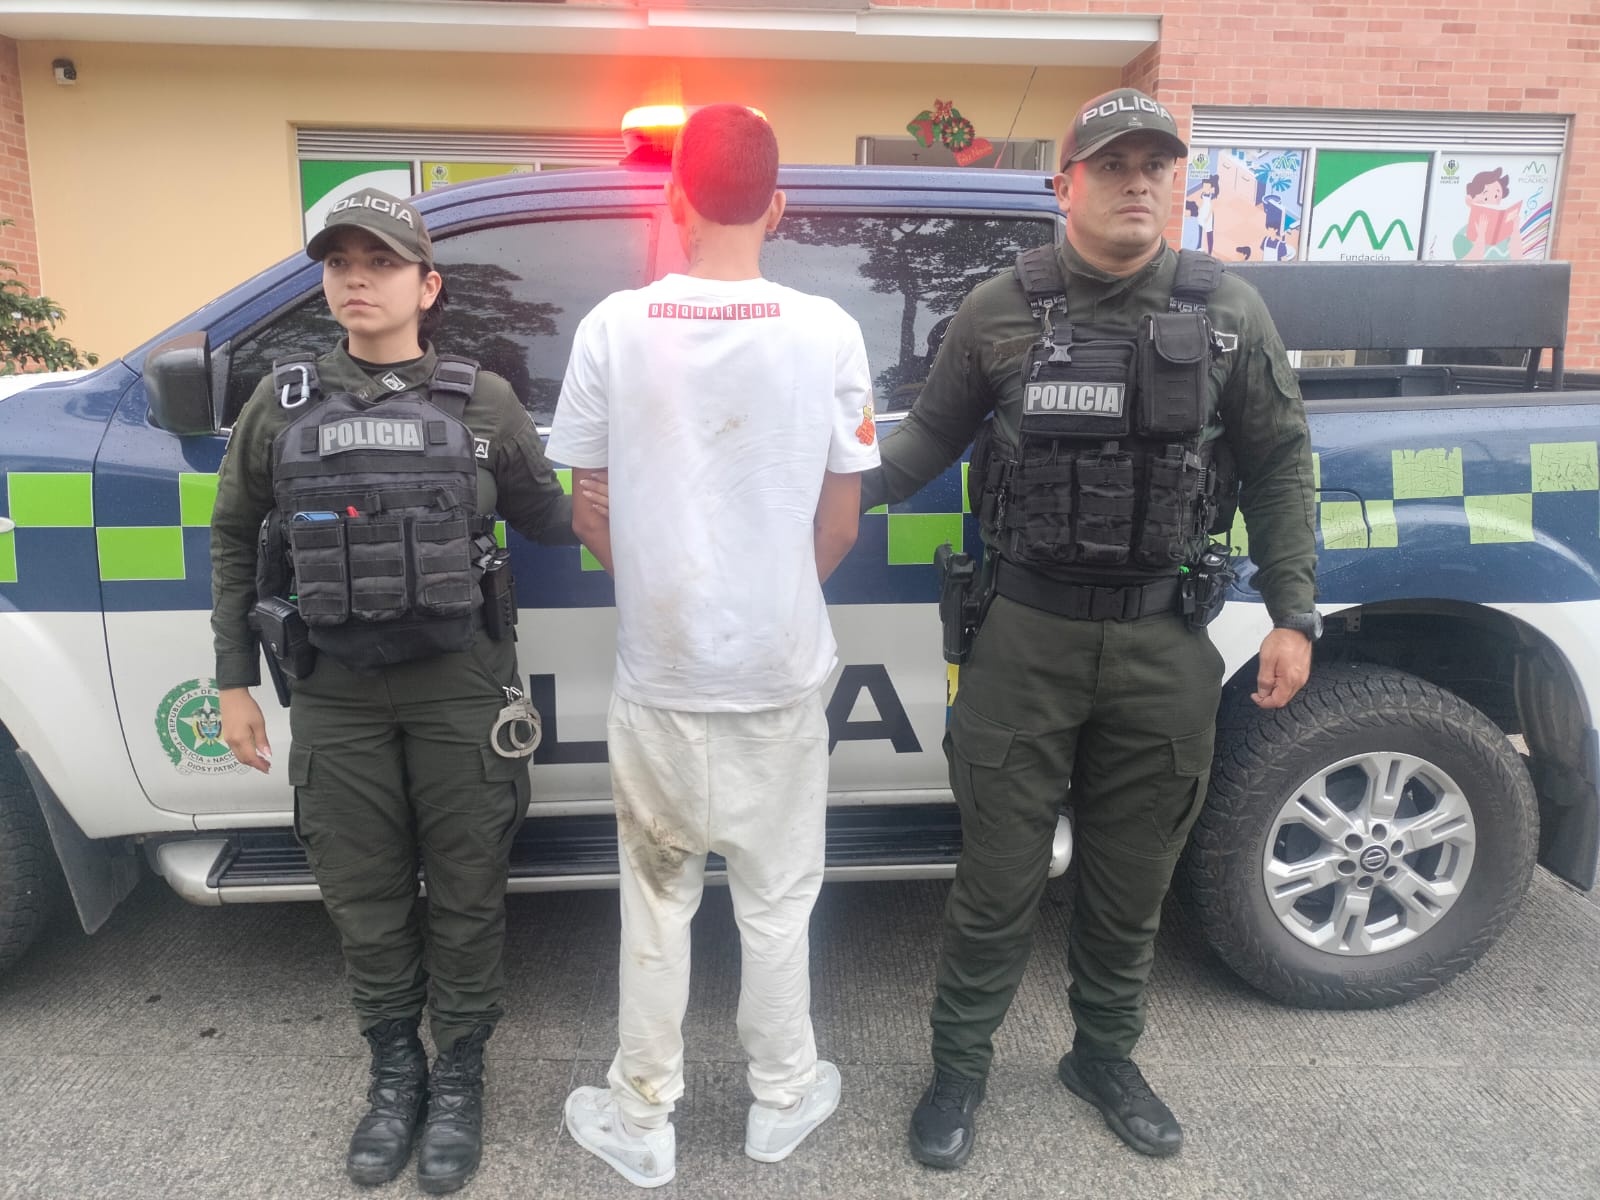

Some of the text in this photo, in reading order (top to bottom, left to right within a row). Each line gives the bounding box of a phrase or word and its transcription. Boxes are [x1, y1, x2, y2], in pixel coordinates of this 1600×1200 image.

[331, 195, 414, 229] OLICÍA
[648, 302, 780, 321] DSQUARED2
[1027, 385, 1119, 413] POLICIA
[323, 421, 421, 451] POLICIA
[176, 741, 204, 762] POLICIA
[213, 760, 239, 772] PATRIA
